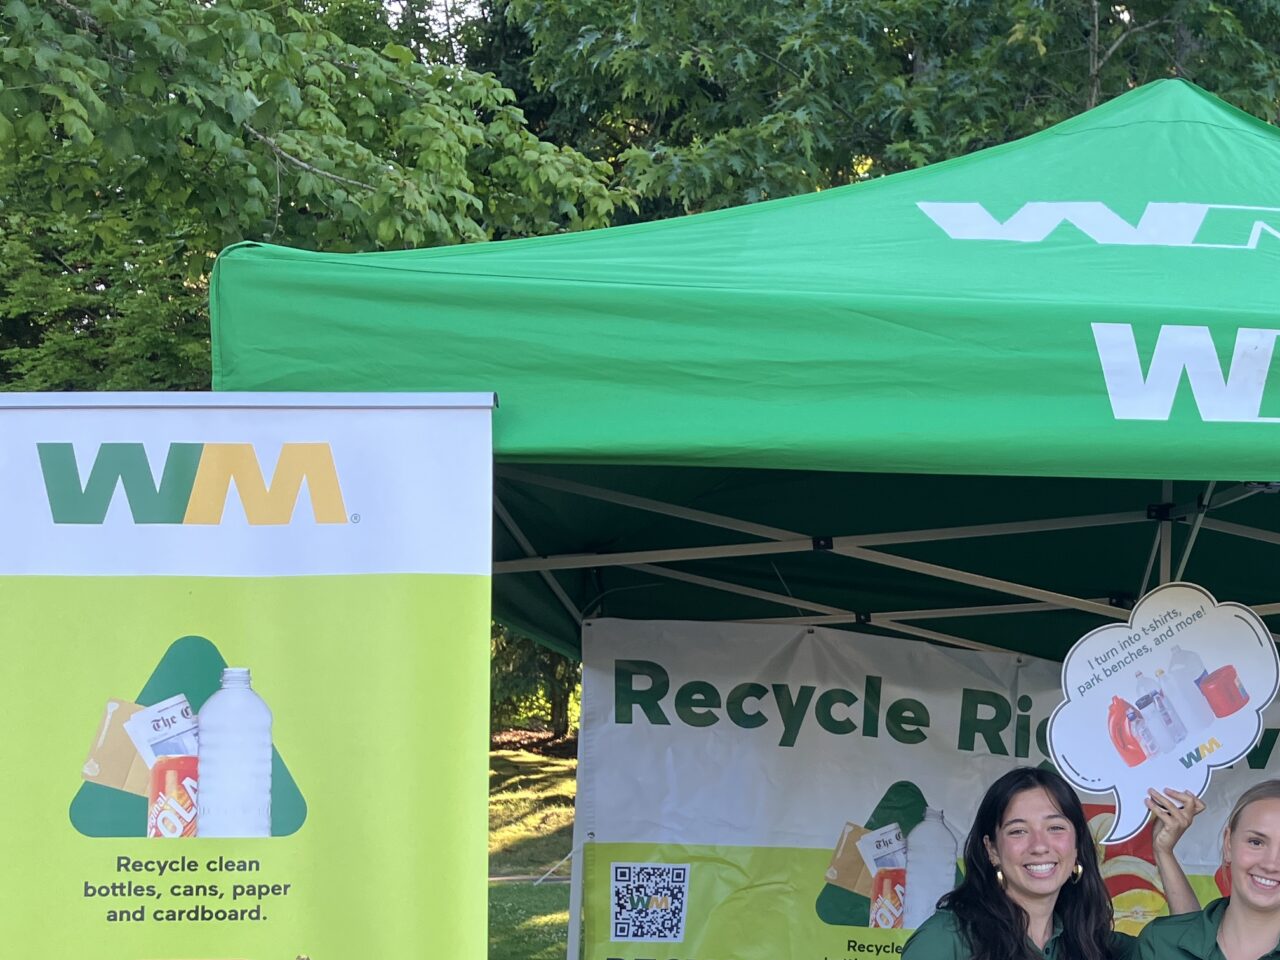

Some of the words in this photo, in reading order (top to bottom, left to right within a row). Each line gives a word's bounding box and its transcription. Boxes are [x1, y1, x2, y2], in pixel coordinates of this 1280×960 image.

[36, 442, 348, 525] WM
[1077, 673, 1103, 696] park
[1105, 643, 1153, 678] benches,
[1154, 626, 1175, 646] and
[1176, 605, 1207, 632] more!
[1087, 659, 1094, 670] I
[1095, 645, 1120, 668] turn
[1119, 632, 1142, 652] into
[1142, 608, 1183, 638] t-shirts,
[614, 659, 930, 747] Recycle
[151, 714, 177, 732] The
[1179, 737, 1221, 769] WM
[116, 856, 199, 877] Recycle
[206, 856, 260, 873] clean
[84, 880, 162, 900] bottles,
[170, 884, 225, 900] cans,
[232, 882, 290, 900] paper
[106, 906, 145, 922] and
[153, 904, 267, 922] cardboard.
[847, 940, 902, 956] Recycle
